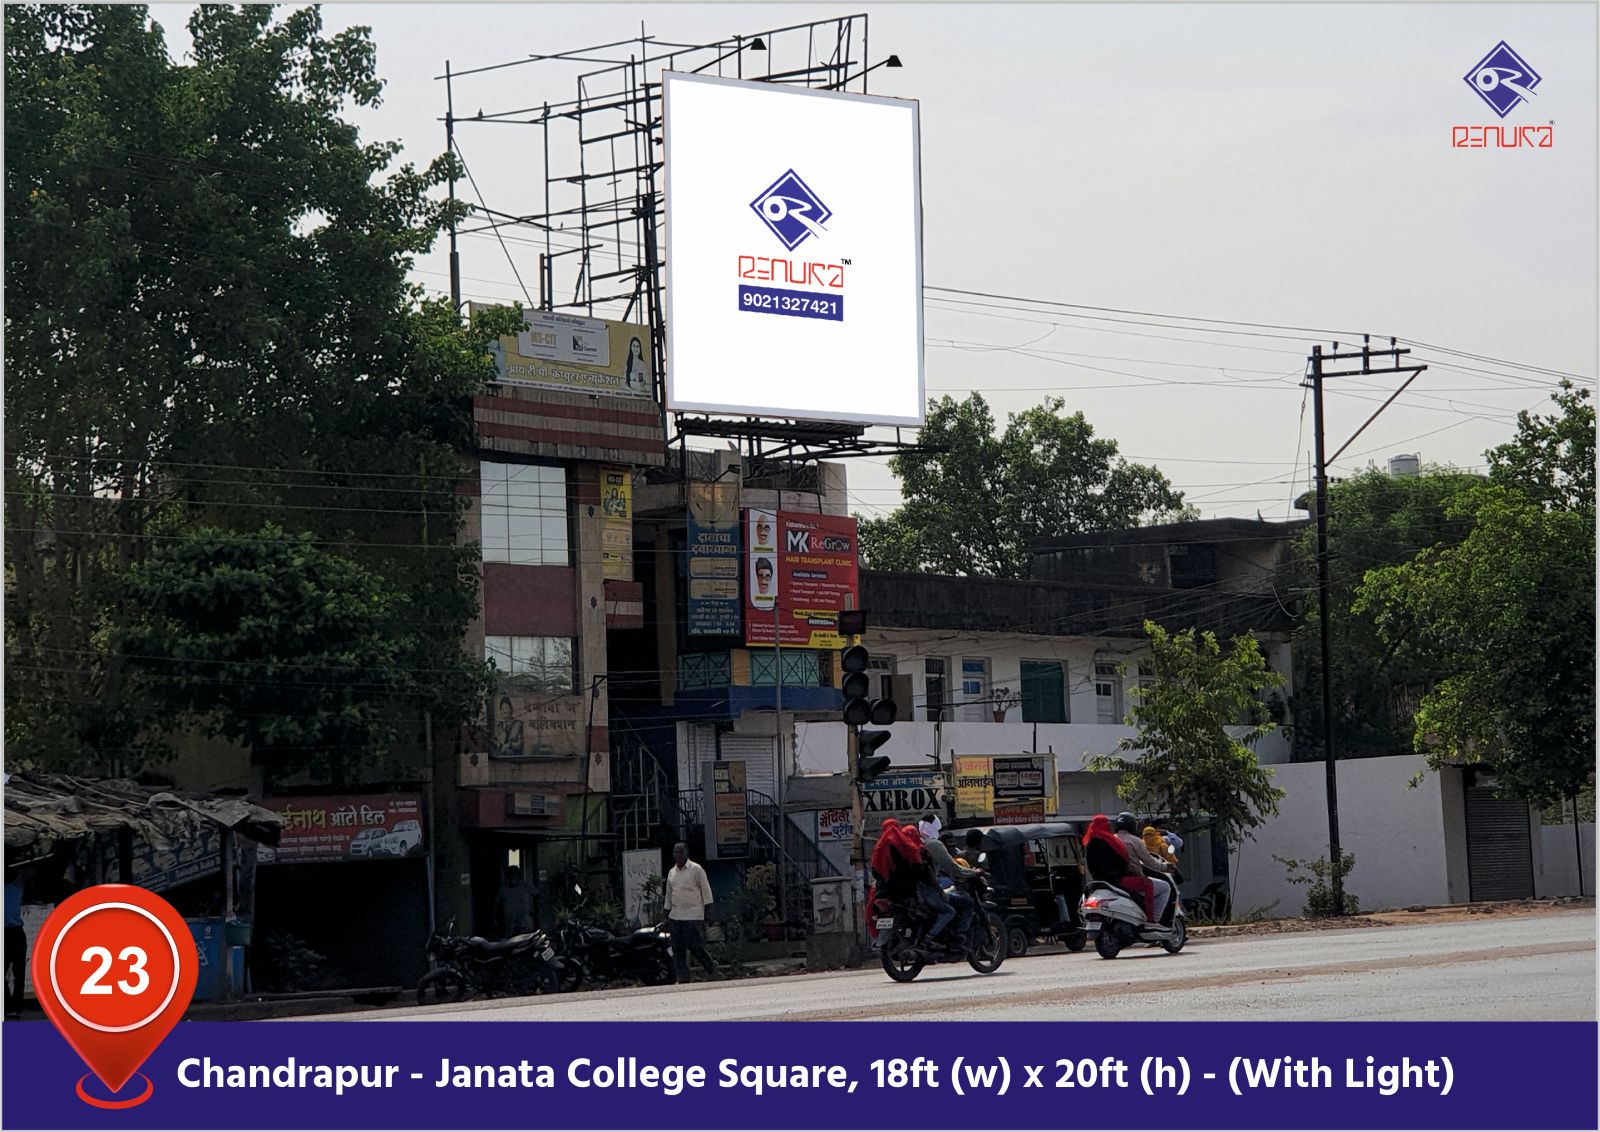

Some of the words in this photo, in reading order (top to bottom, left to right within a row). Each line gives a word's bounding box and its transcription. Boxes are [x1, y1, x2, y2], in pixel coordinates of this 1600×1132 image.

[738, 255, 844, 288] RENUKA
[743, 293, 837, 315] 9021327421
[787, 530, 809, 553] MK
[811, 536, 850, 551] ReGrow
[785, 555, 800, 563] HAIR
[800, 556, 834, 565] TRANSPLANT
[835, 559, 853, 567] CLINIC
[957, 774, 994, 788] ऑनलाईन
[863, 789, 942, 812] XEROX
[330, 804, 358, 827] ऑटो
